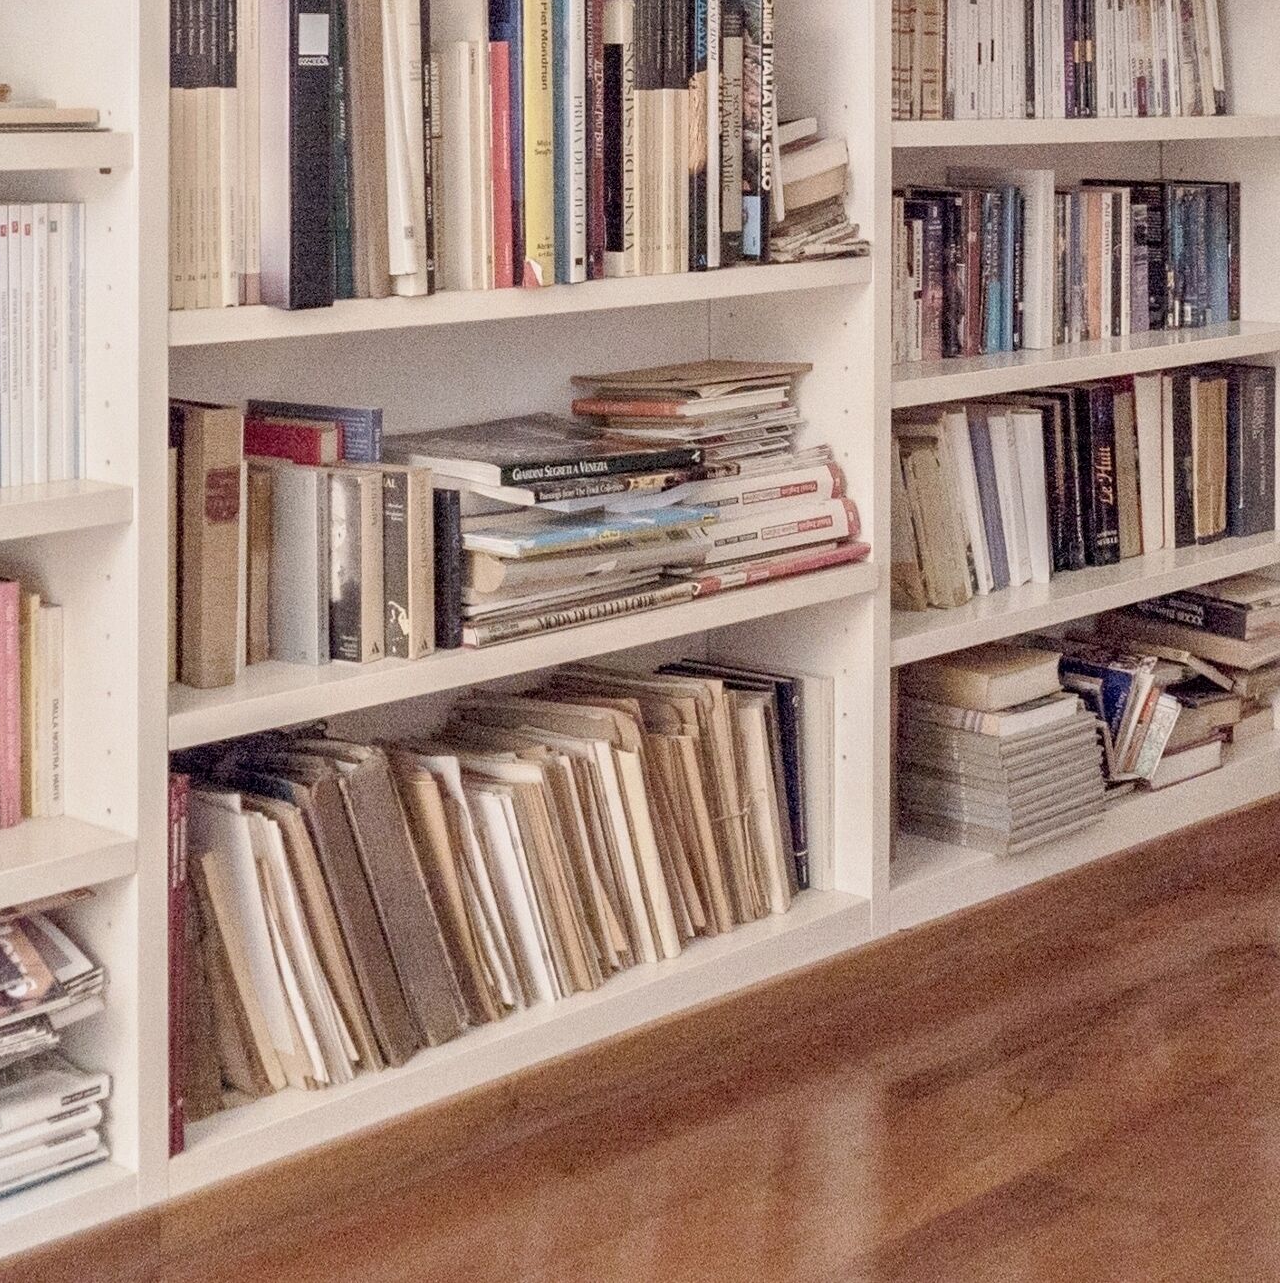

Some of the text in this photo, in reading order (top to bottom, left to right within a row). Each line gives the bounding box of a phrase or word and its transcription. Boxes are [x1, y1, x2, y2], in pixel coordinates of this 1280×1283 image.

[540, 1, 550, 91] Piet Mondrian
[430, 60, 441, 133] ANTIQUARIATO
[622, 41, 635, 127] SAISONS
[762, 47, 775, 102] ITALIA
[732, 93, 742, 139] secolo
[762, 107, 774, 140] DAL
[572, 95, 584, 236] PRIMA DEL CIELO
[723, 153, 735, 193] Mille
[761, 142, 773, 191] CIELO
[622, 184, 635, 252] VENISE
[511, 466, 544, 482] GIARDINI
[544, 463, 571, 479] SEGRETI
[578, 459, 609, 475] VENEZIA
[1094, 446, 1116, 506] Le Huit
[536, 611, 572, 630] MODA
[51, 698, 60, 728] DALLA
[51, 731, 60, 770] NOSTRA
